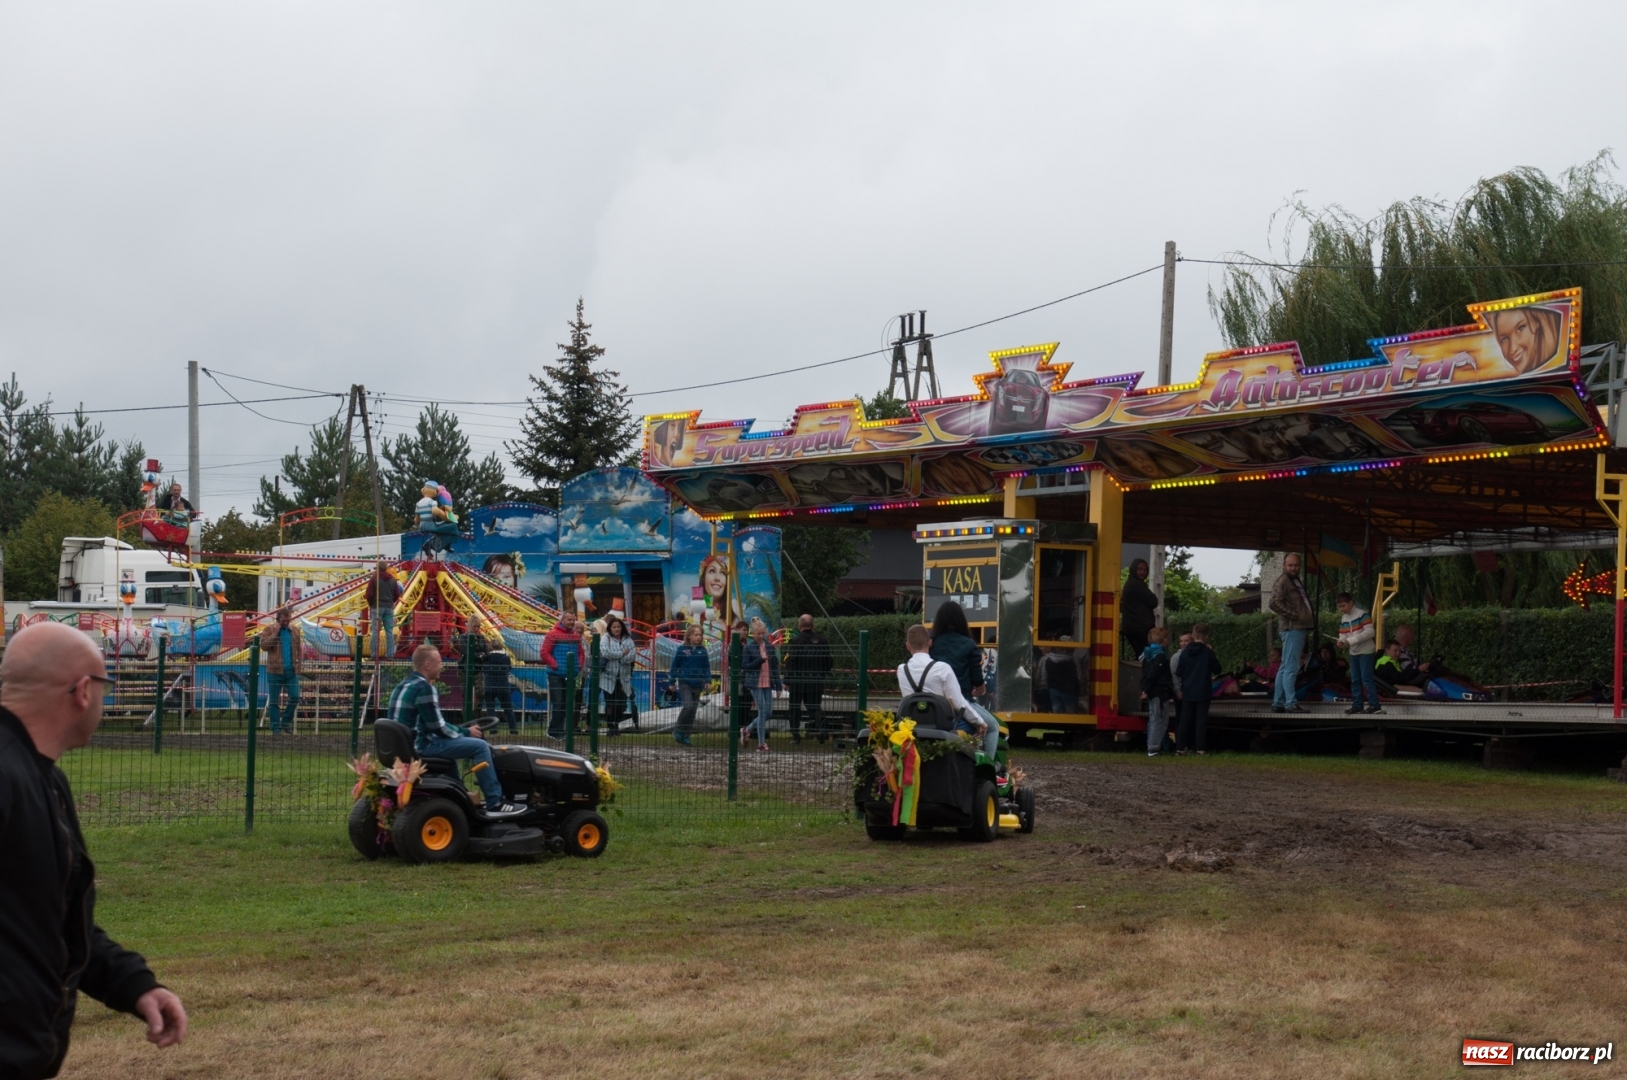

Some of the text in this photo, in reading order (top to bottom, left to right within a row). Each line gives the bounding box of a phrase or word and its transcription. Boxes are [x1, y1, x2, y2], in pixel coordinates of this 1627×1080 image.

[1200, 347, 1478, 413] Autoscooter
[691, 414, 859, 464] Superspeed
[943, 566, 983, 595] KASA
